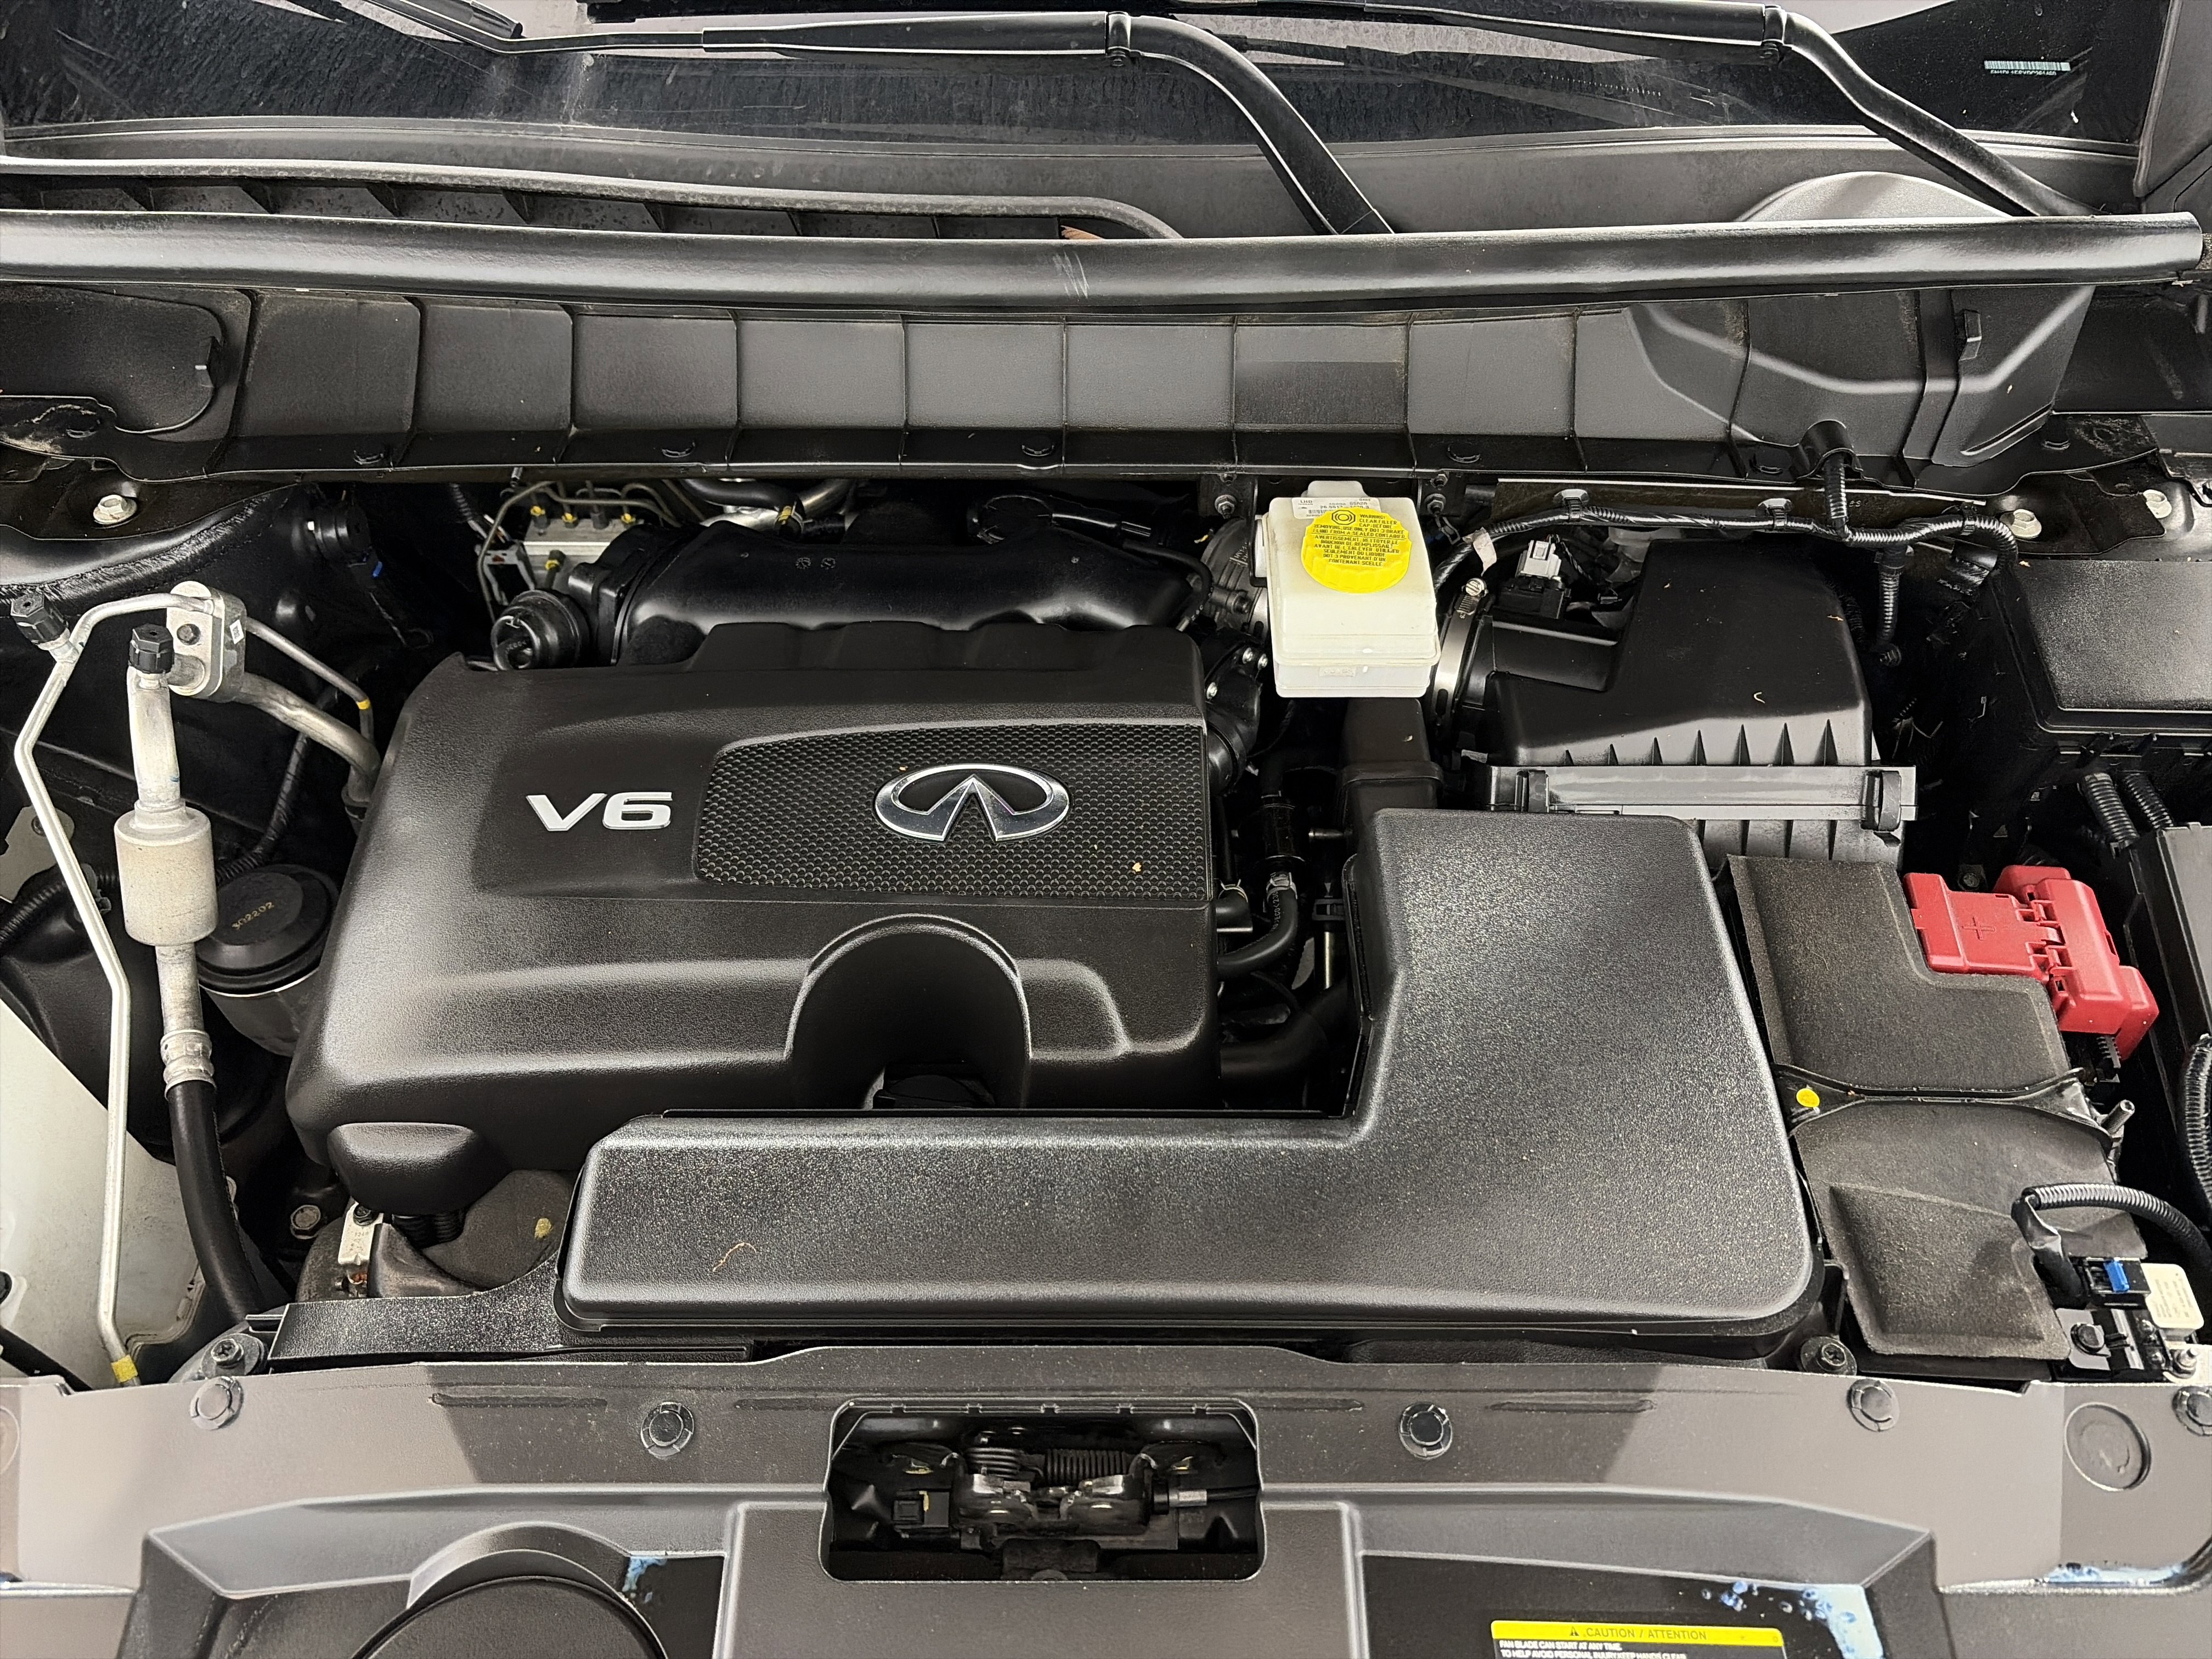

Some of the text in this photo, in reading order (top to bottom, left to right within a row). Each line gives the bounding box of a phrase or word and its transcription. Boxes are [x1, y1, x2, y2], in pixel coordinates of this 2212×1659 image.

[526, 792, 673, 832] V6
[1585, 1627, 1707, 1640] CAUTION / ATTENTION
[1499, 1640, 1514, 1648] FAN
[1514, 1640, 1538, 1649] BLADE
[1538, 1641, 1555, 1649] CAN
[1555, 1641, 1578, 1650] START
[1578, 1642, 1588, 1650] AT
[1500, 1649, 1511, 1658] TO
[1512, 1650, 1531, 1658] HELP
[1532, 1650, 1554, 1658] AVOID
[1554, 1651, 1593, 1659] PERSONAL
